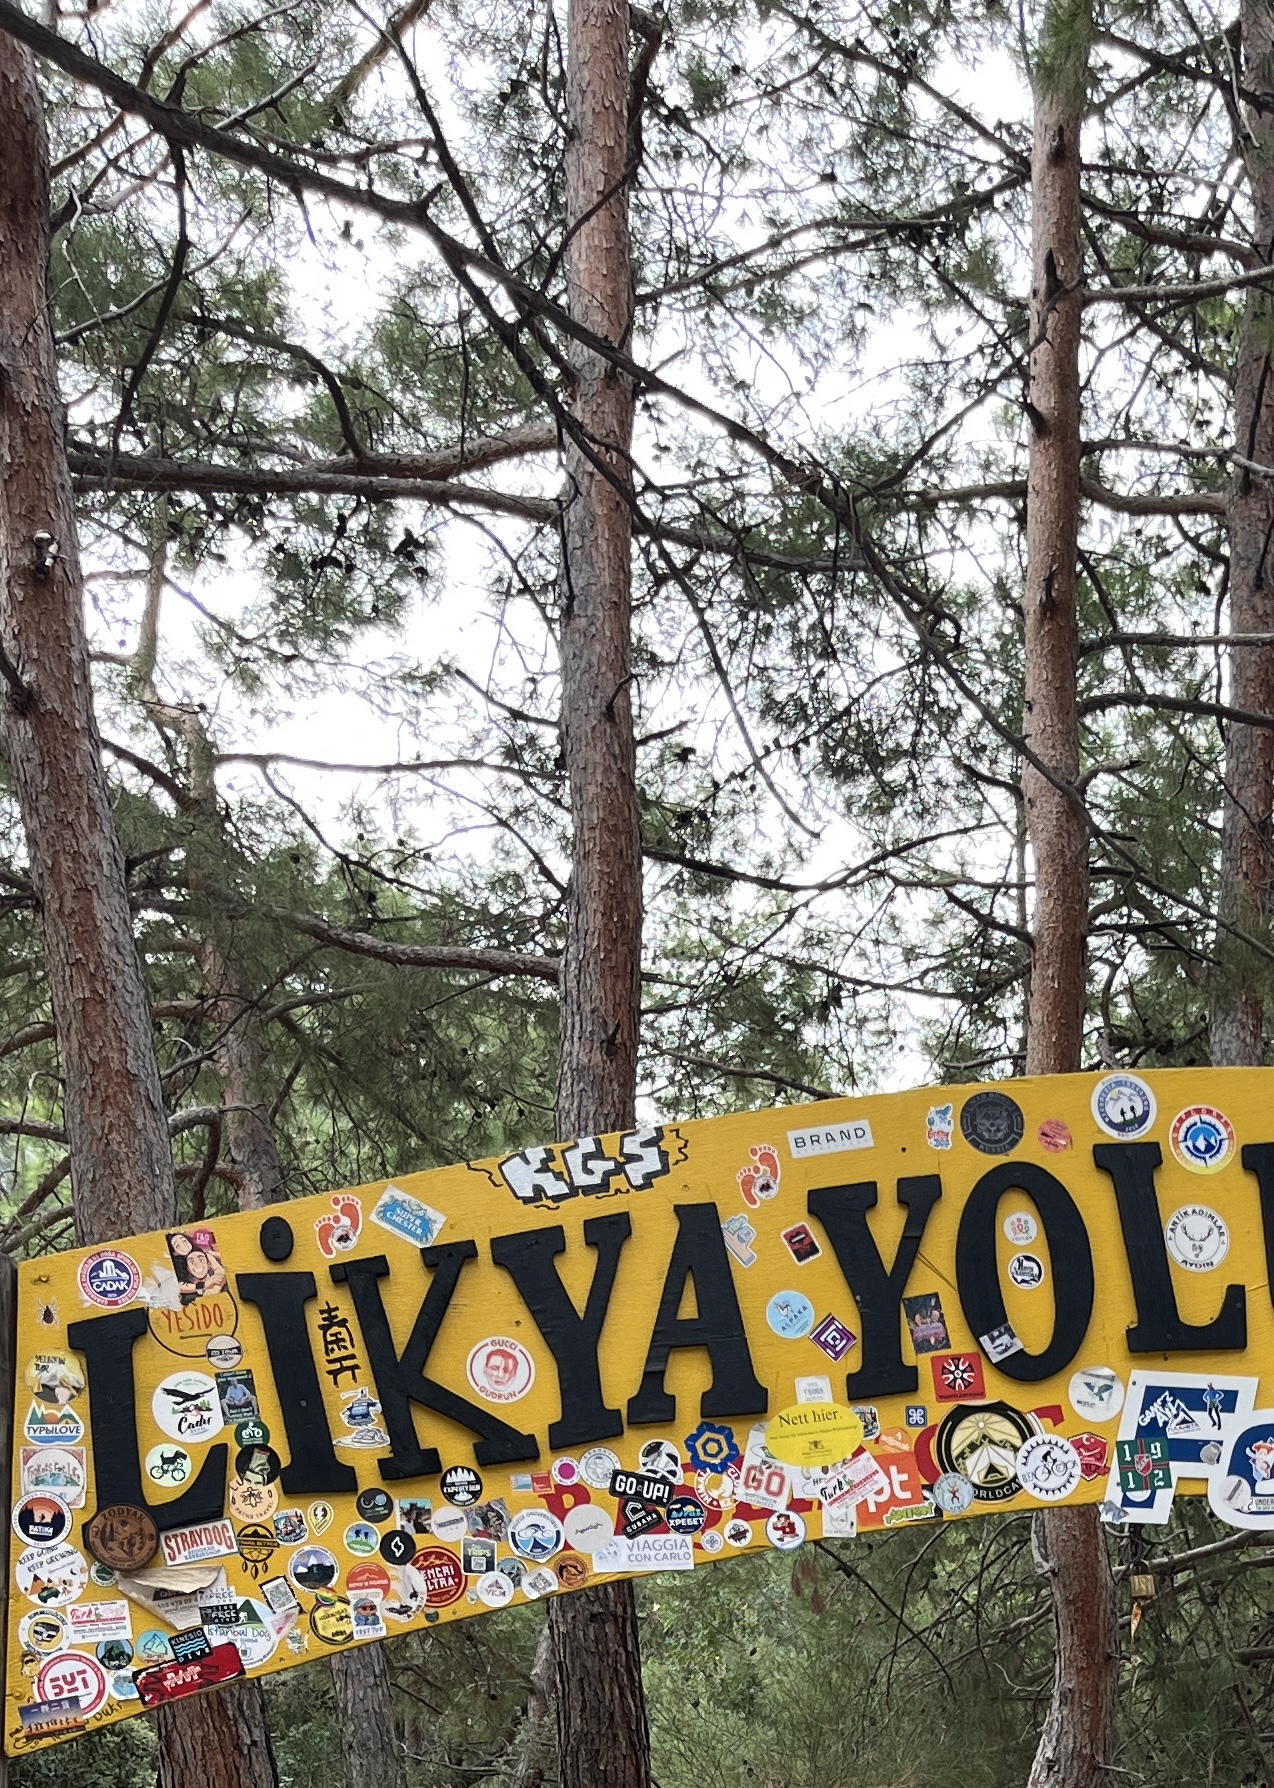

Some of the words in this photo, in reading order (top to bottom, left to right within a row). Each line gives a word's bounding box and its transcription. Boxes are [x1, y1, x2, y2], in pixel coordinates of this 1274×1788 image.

[794, 1127, 866, 1148] BRAND
[386, 1211, 424, 1236] CHESTER
[396, 1207, 422, 1226] SUPER
[1168, 1209, 1190, 1234] ANTİK
[1191, 1207, 1225, 1238] ADIMLAR
[1180, 1258, 1215, 1269] AYDIN
[92, 1281, 128, 1292] CADAK
[781, 1304, 809, 1333] ALPAKA
[490, 1339, 519, 1351] GUCCI
[67, 1201, 768, 1550] LİKYA
[478, 1386, 518, 1400] GUDRUN
[778, 1413, 810, 1428] Nett
[811, 1409, 844, 1424] hier.
[1123, 1443, 1132, 1462] 1
[1150, 1440, 1162, 1460] 9
[615, 1475, 636, 1494] GO
[641, 1480, 670, 1503] UP!
[1127, 1471, 1136, 1490] 1
[1153, 1469, 1165, 1487] 2
[164, 1523, 234, 1562] STRAYDOG
[627, 1538, 690, 1553] VIAGGIA
[18, 1551, 37, 1566] KEEP
[27, 1560, 45, 1573] KEEP
[46, 1549, 79, 1567] GROWING
[467, 1548, 492, 1558] TRIPS
[628, 1553, 652, 1563] CON
[654, 1552, 692, 1562] CARLO
[171, 1630, 204, 1646] KINESIO
[178, 1647, 210, 1664] DIVE
